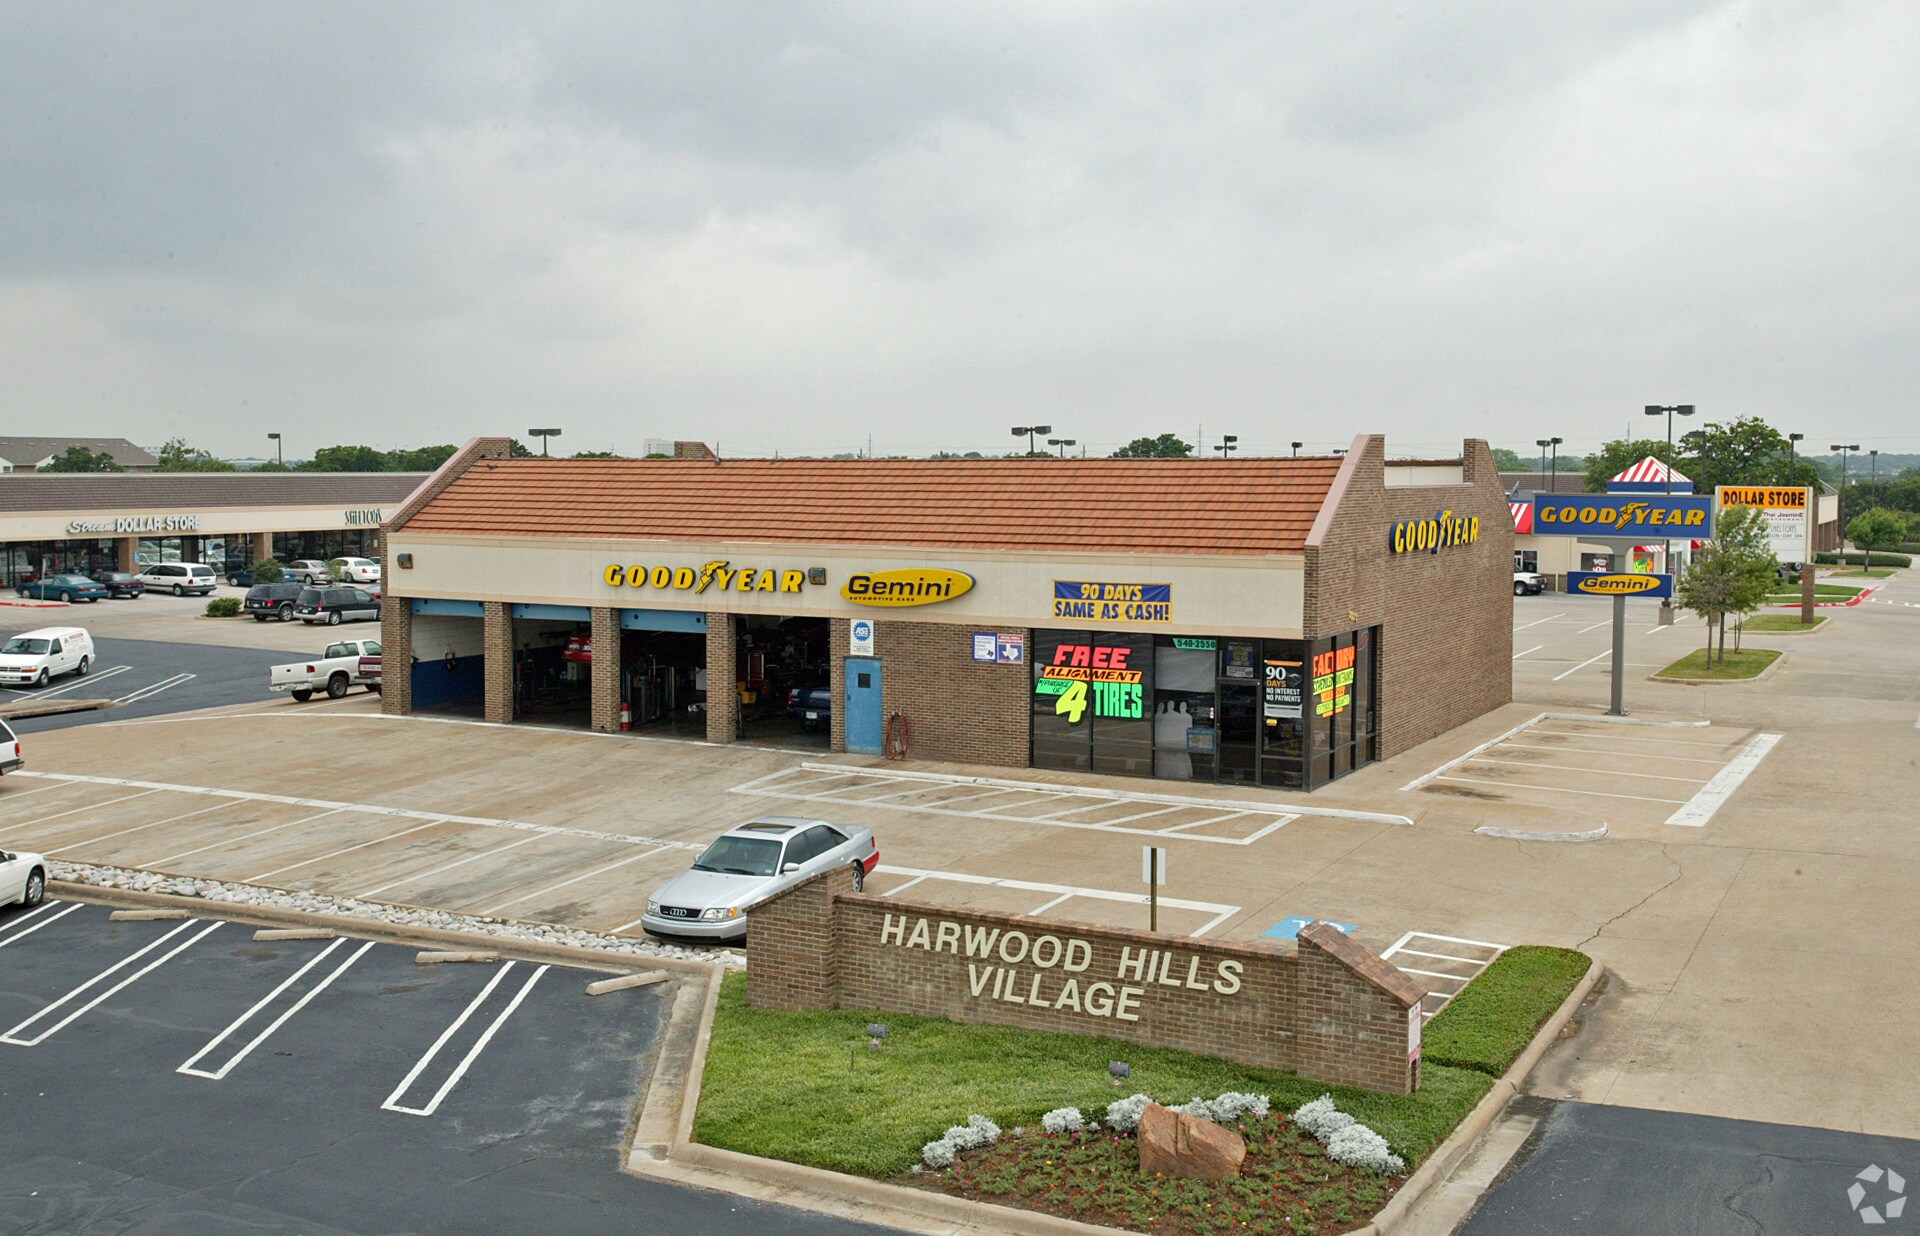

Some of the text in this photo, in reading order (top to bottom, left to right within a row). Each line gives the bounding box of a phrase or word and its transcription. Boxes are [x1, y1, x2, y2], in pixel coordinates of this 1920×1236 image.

[1723, 491, 1805, 506] DOLLAR STORE
[848, 575, 952, 597] Gemini
[1080, 583, 1143, 601] 90 DAYS
[1583, 577, 1650, 590] Gemini
[1055, 601, 1169, 621] SAME AS CASH!
[1052, 644, 1132, 669] FREE
[1045, 668, 1139, 681] ALIGNMENT
[1265, 666, 1287, 680] 90
[1274, 688, 1300, 696] INTEREST
[1274, 695, 1301, 703] PAYMENTS
[1055, 680, 1143, 723] 4 TIRES
[880, 913, 1244, 995] HARWOOD HILLS
[967, 963, 1145, 1021] VILLAGE
